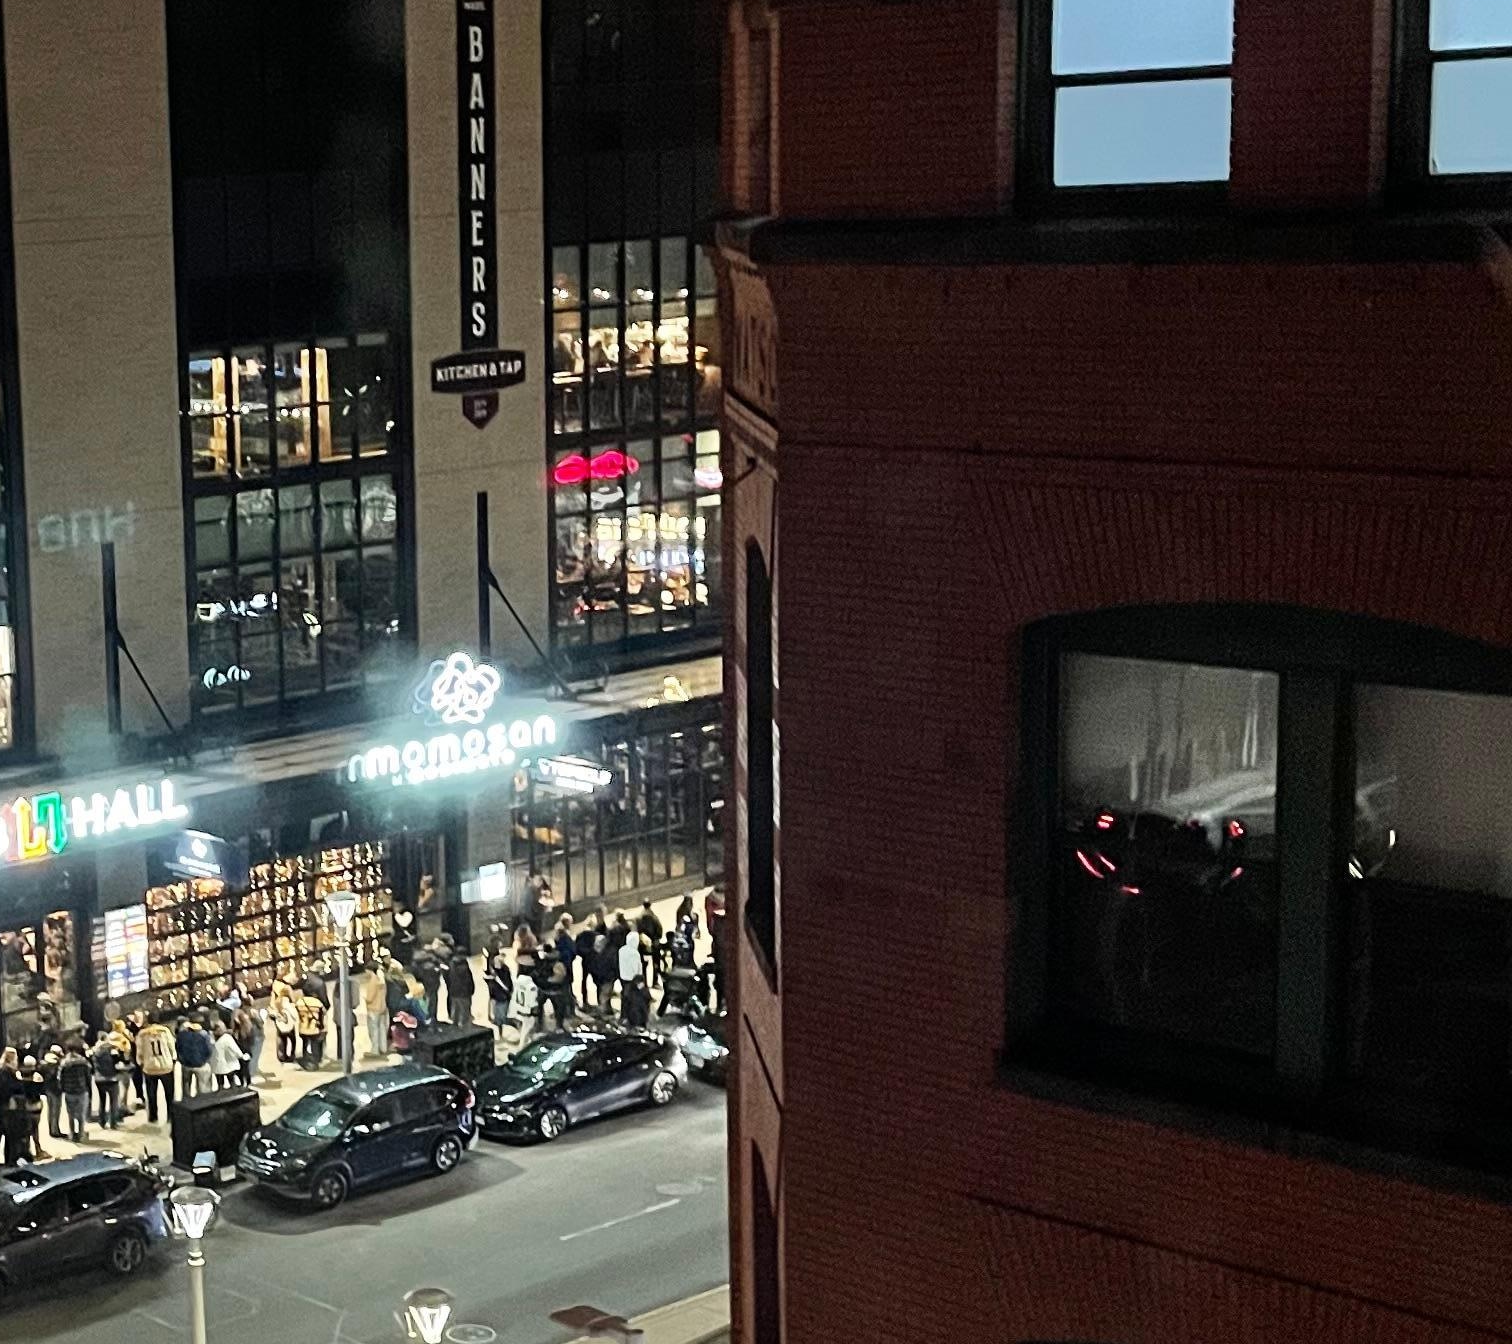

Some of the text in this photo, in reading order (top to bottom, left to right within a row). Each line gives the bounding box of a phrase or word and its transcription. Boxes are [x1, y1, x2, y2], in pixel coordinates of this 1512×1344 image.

[468, 25, 487, 338] BANNERS
[436, 363, 488, 382] KITCHEN
[499, 360, 522, 375] TAP
[364, 714, 557, 780] momosan
[72, 778, 188, 838] HALL
